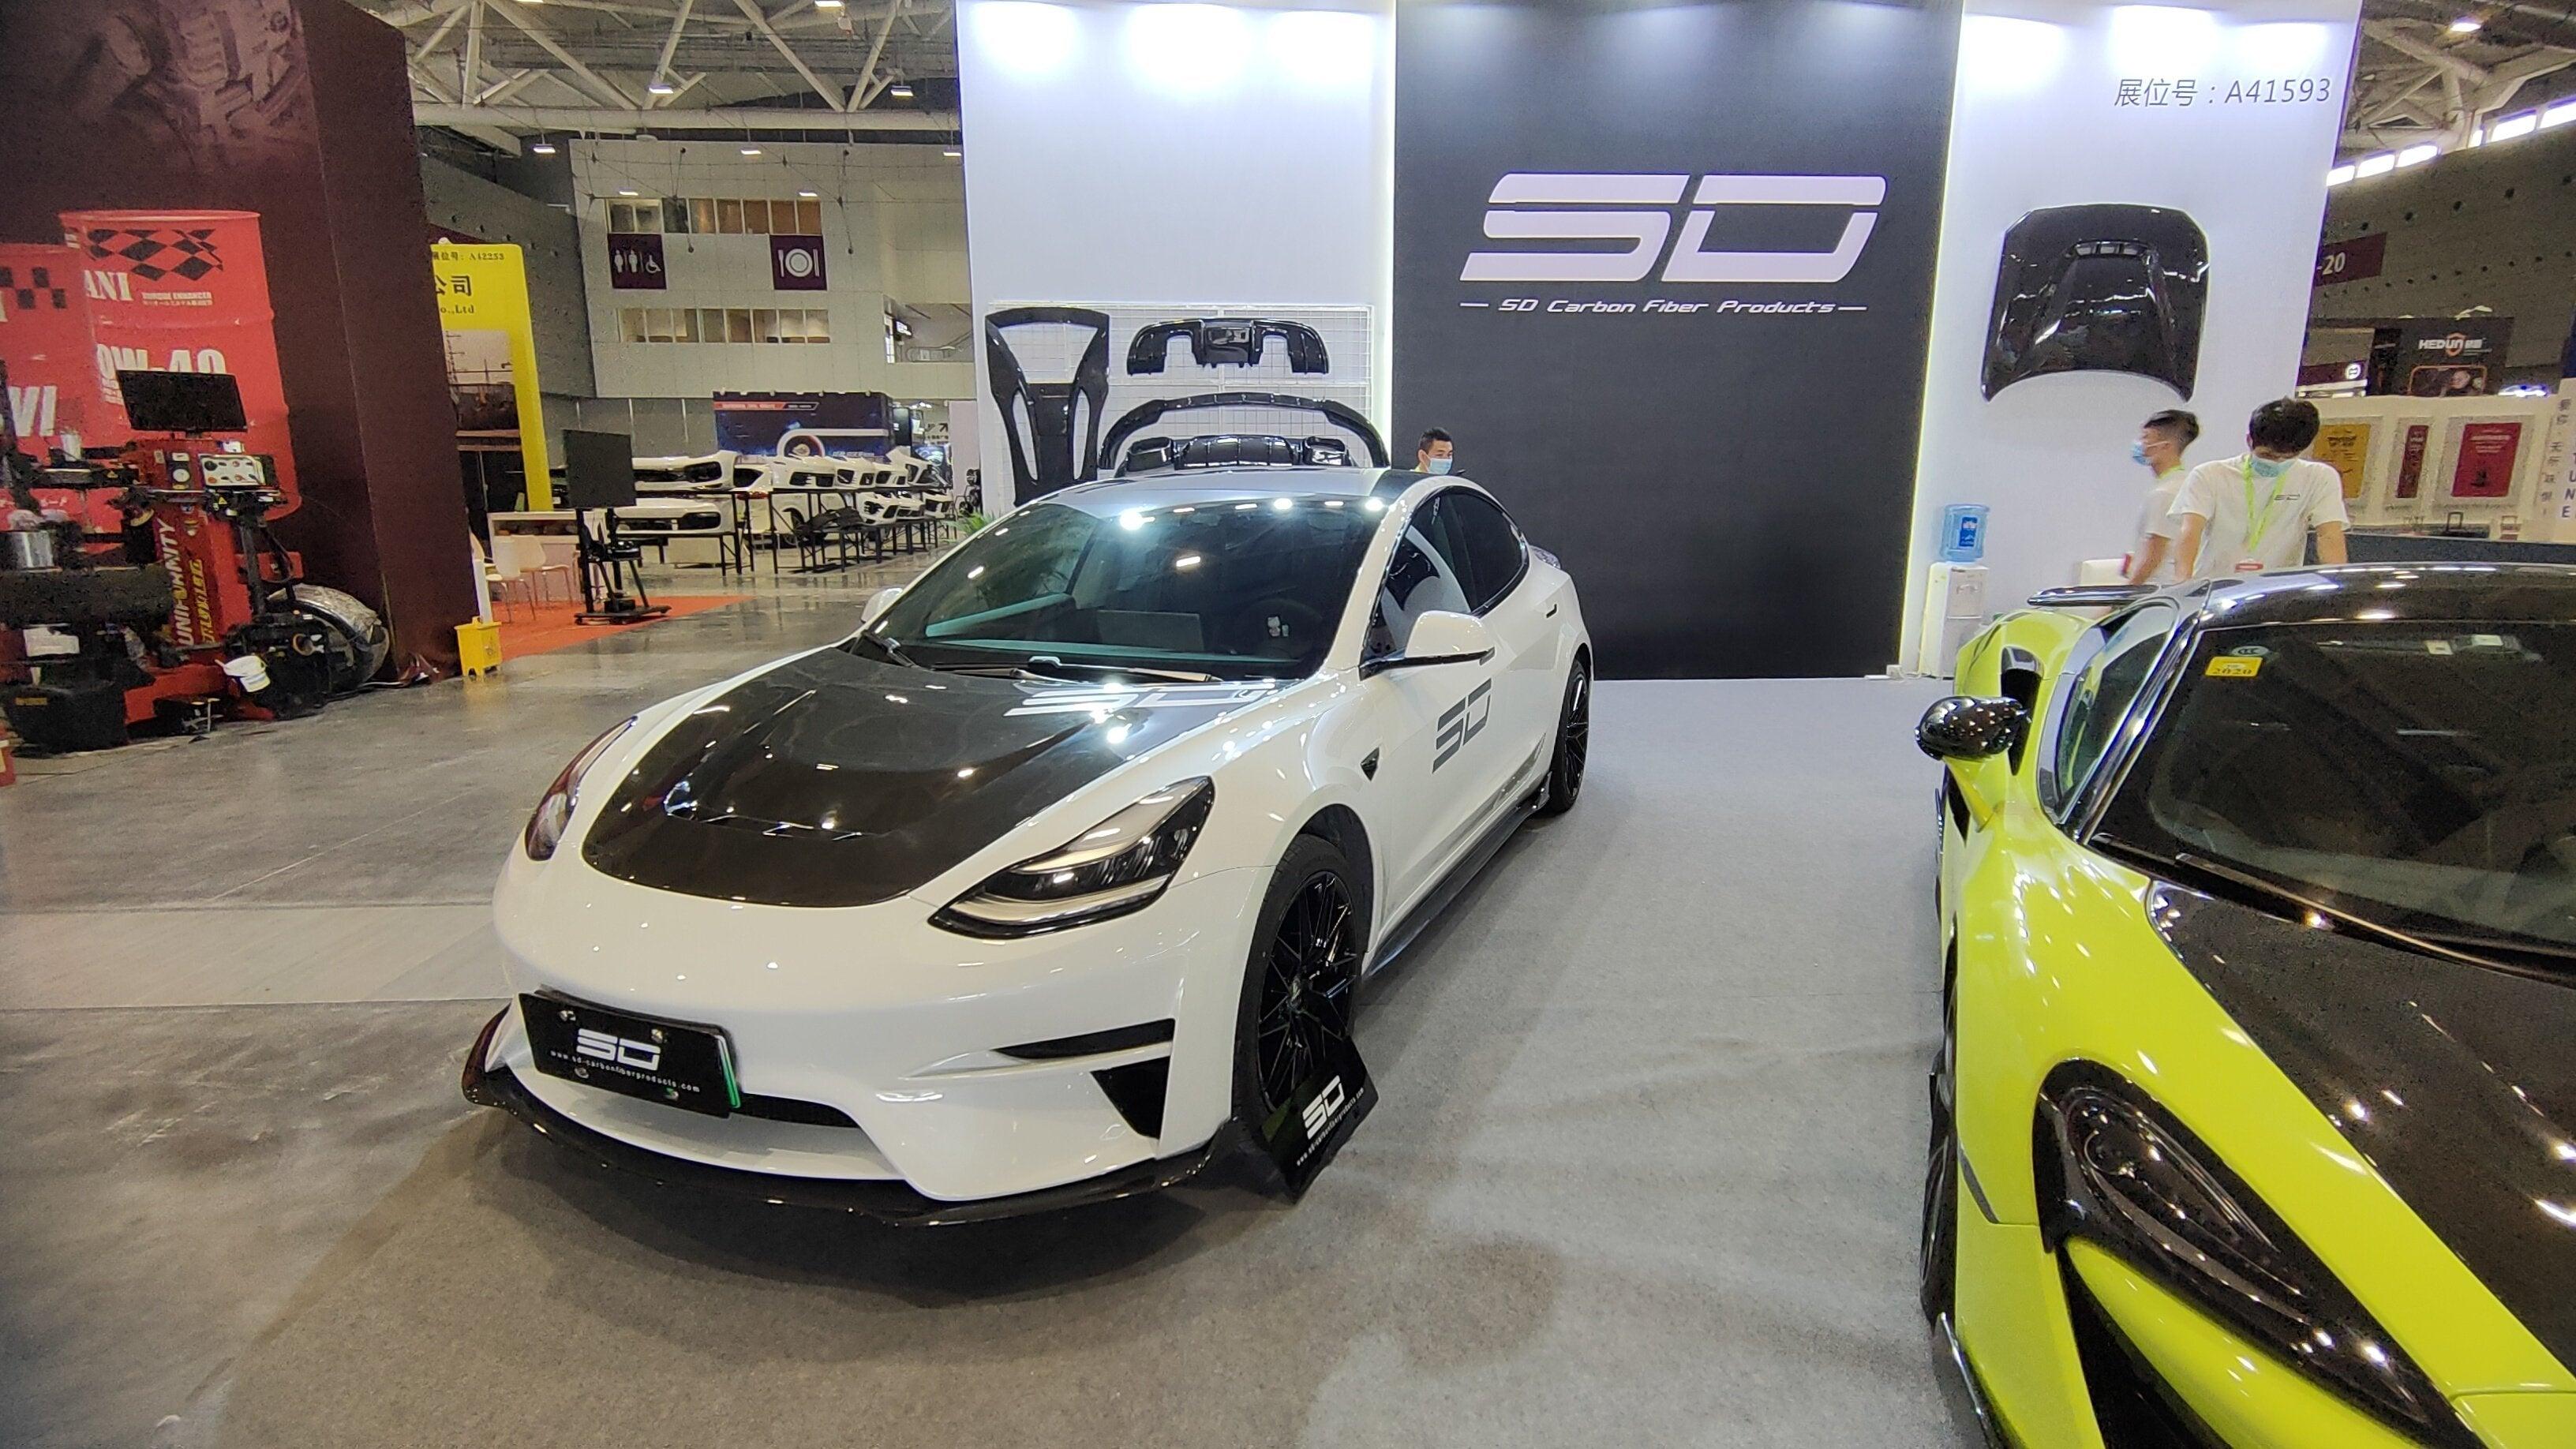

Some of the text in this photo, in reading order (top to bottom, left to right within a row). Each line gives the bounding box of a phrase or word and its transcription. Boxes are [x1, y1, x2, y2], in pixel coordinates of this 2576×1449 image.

[1460, 173, 1887, 283] SD
[1498, 298, 1836, 314] SD Carbon Fiber Products
[1432, 677, 1492, 774] SD
[576, 1028, 661, 1072] SD
[1302, 1075, 1345, 1140] SD
